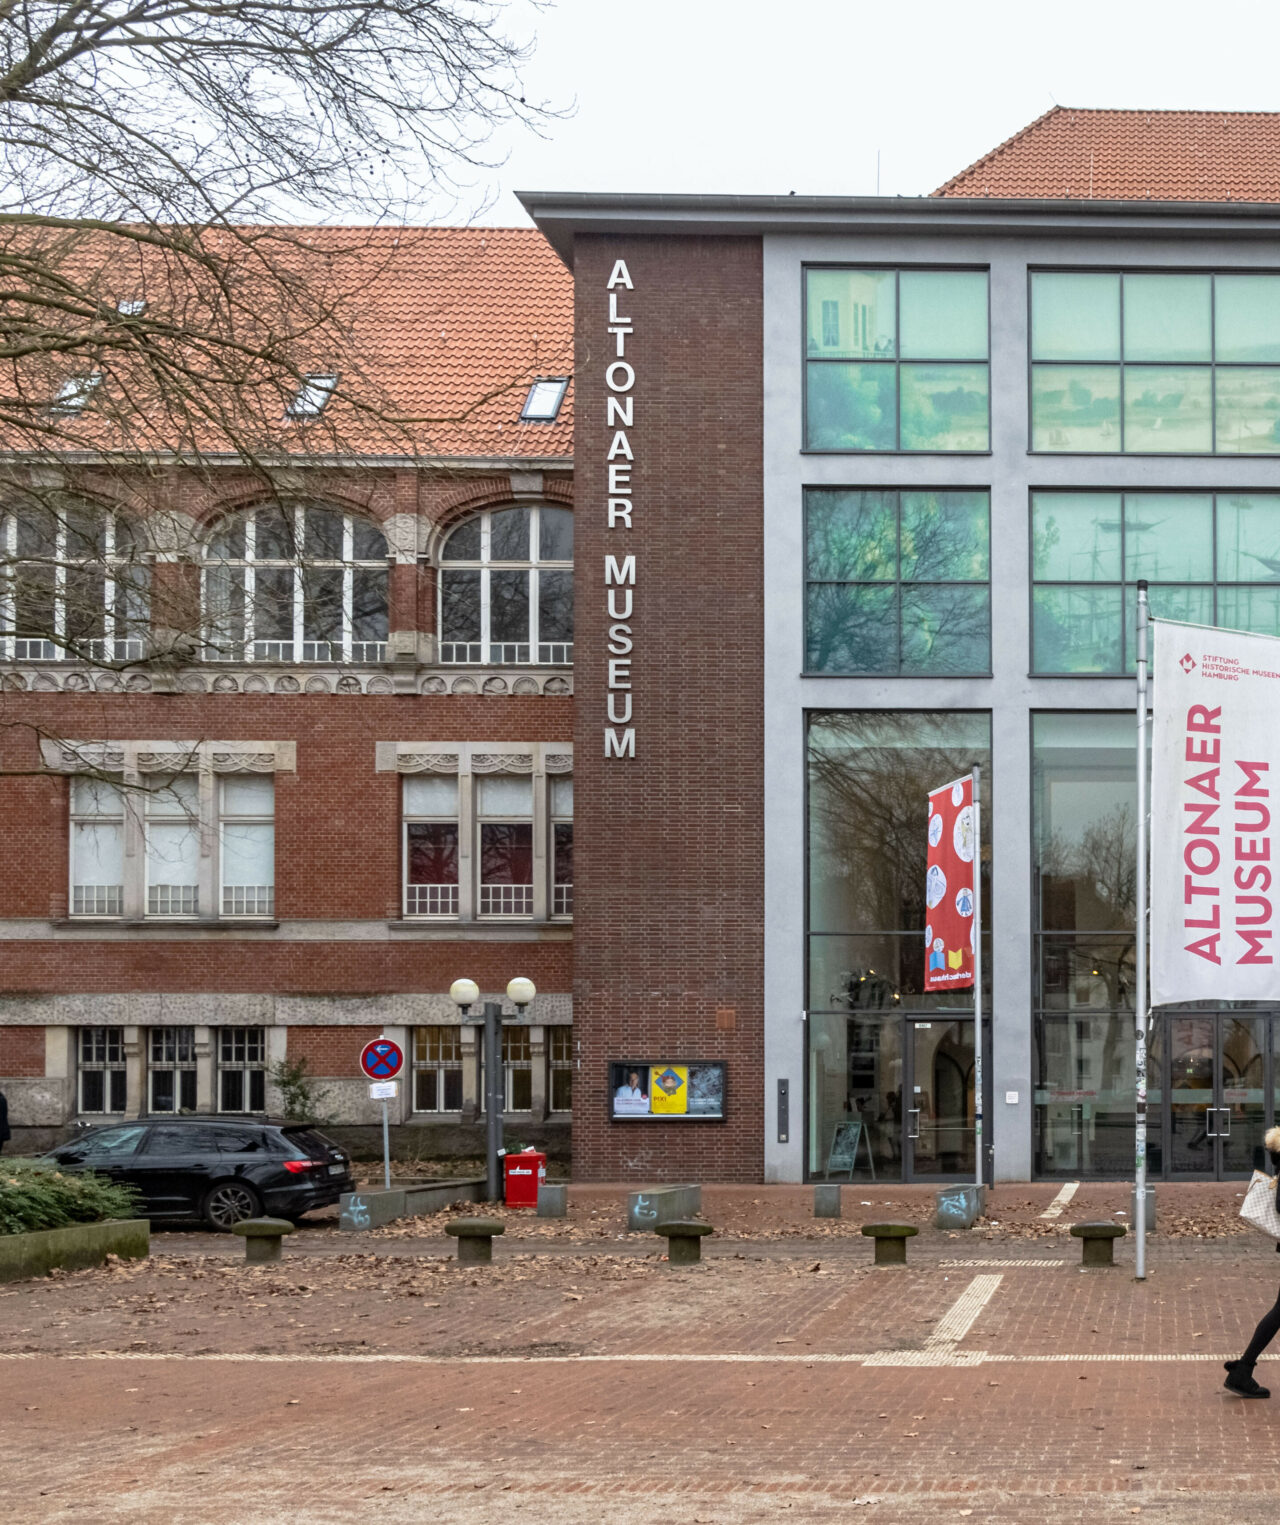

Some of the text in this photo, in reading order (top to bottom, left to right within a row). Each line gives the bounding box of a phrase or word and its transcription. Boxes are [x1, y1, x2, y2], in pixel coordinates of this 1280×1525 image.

[604, 259, 636, 758] ALTONAER MUSEUM
[1201, 671, 1239, 681] HAMBURG
[1202, 654, 1239, 665] STIFTUNG
[1202, 662, 1280, 679] HISTORISCHE MUSEEN
[1184, 704, 1222, 966] ALTONAER
[1234, 760, 1273, 965] MUSEUM
